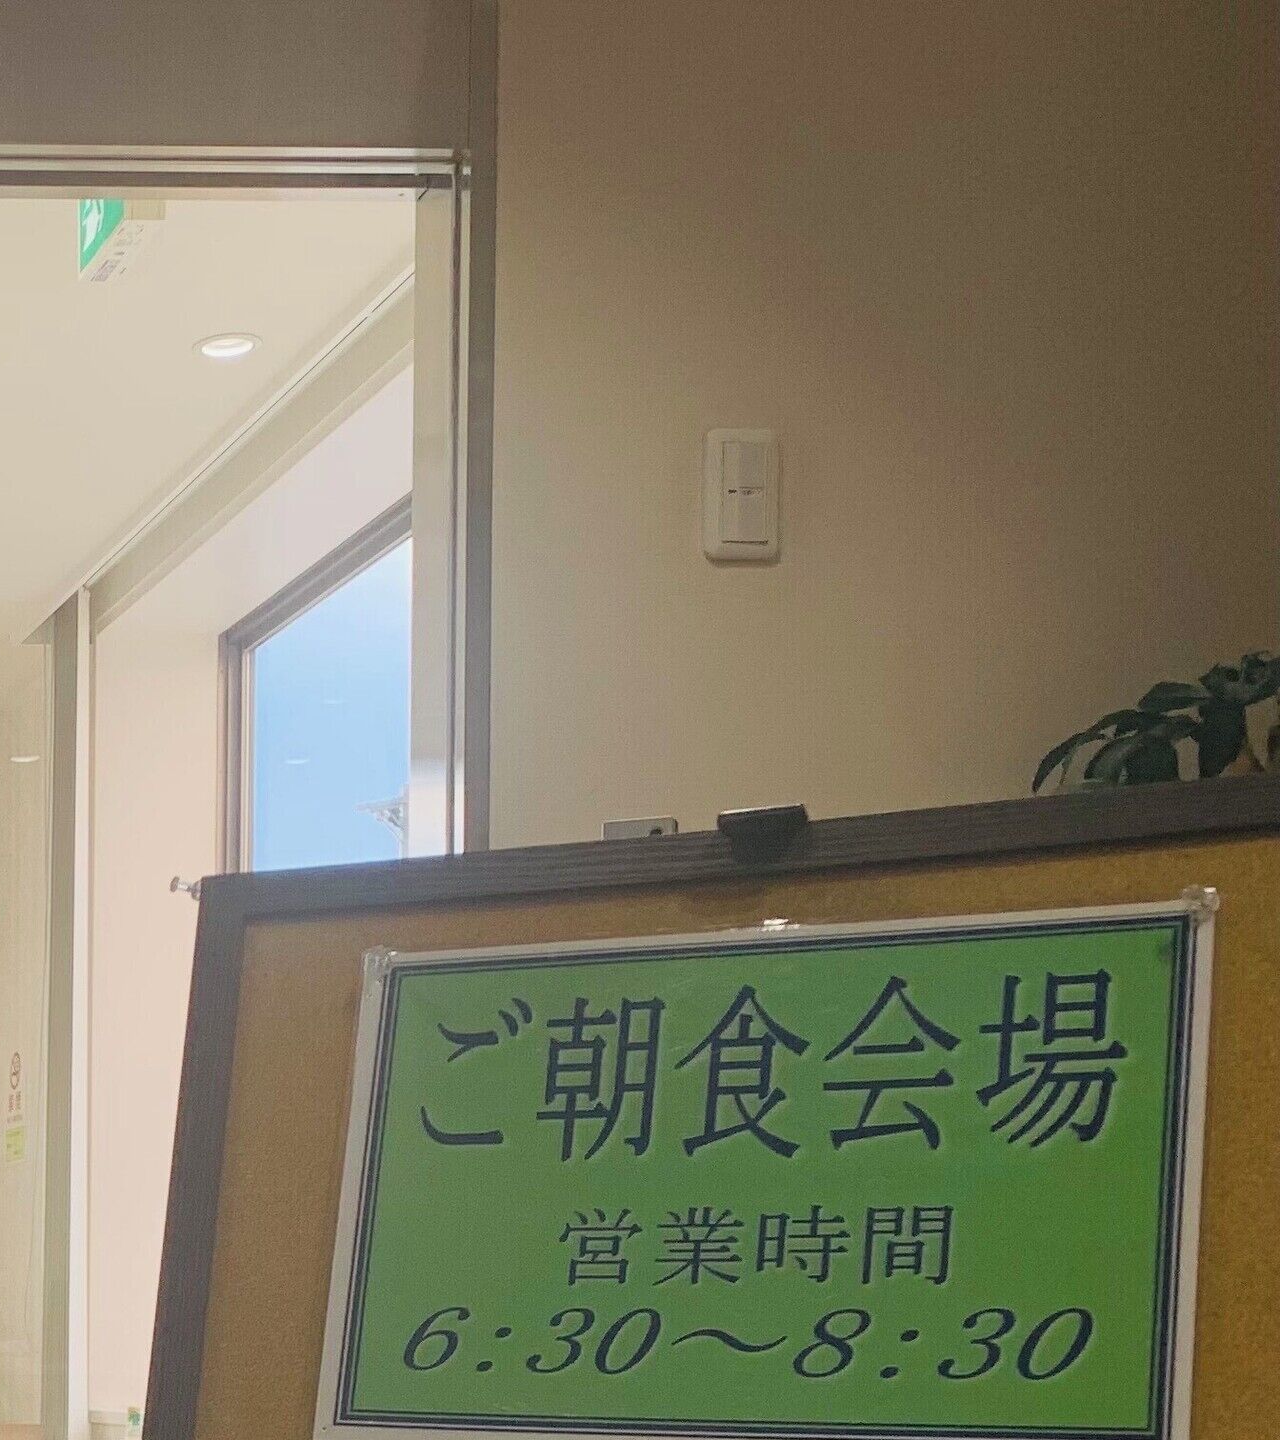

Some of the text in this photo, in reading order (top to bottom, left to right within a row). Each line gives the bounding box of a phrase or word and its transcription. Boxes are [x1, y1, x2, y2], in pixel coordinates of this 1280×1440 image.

[419, 967, 1130, 1163] ご朝食会場
[558, 1203, 955, 1287] 営業時間
